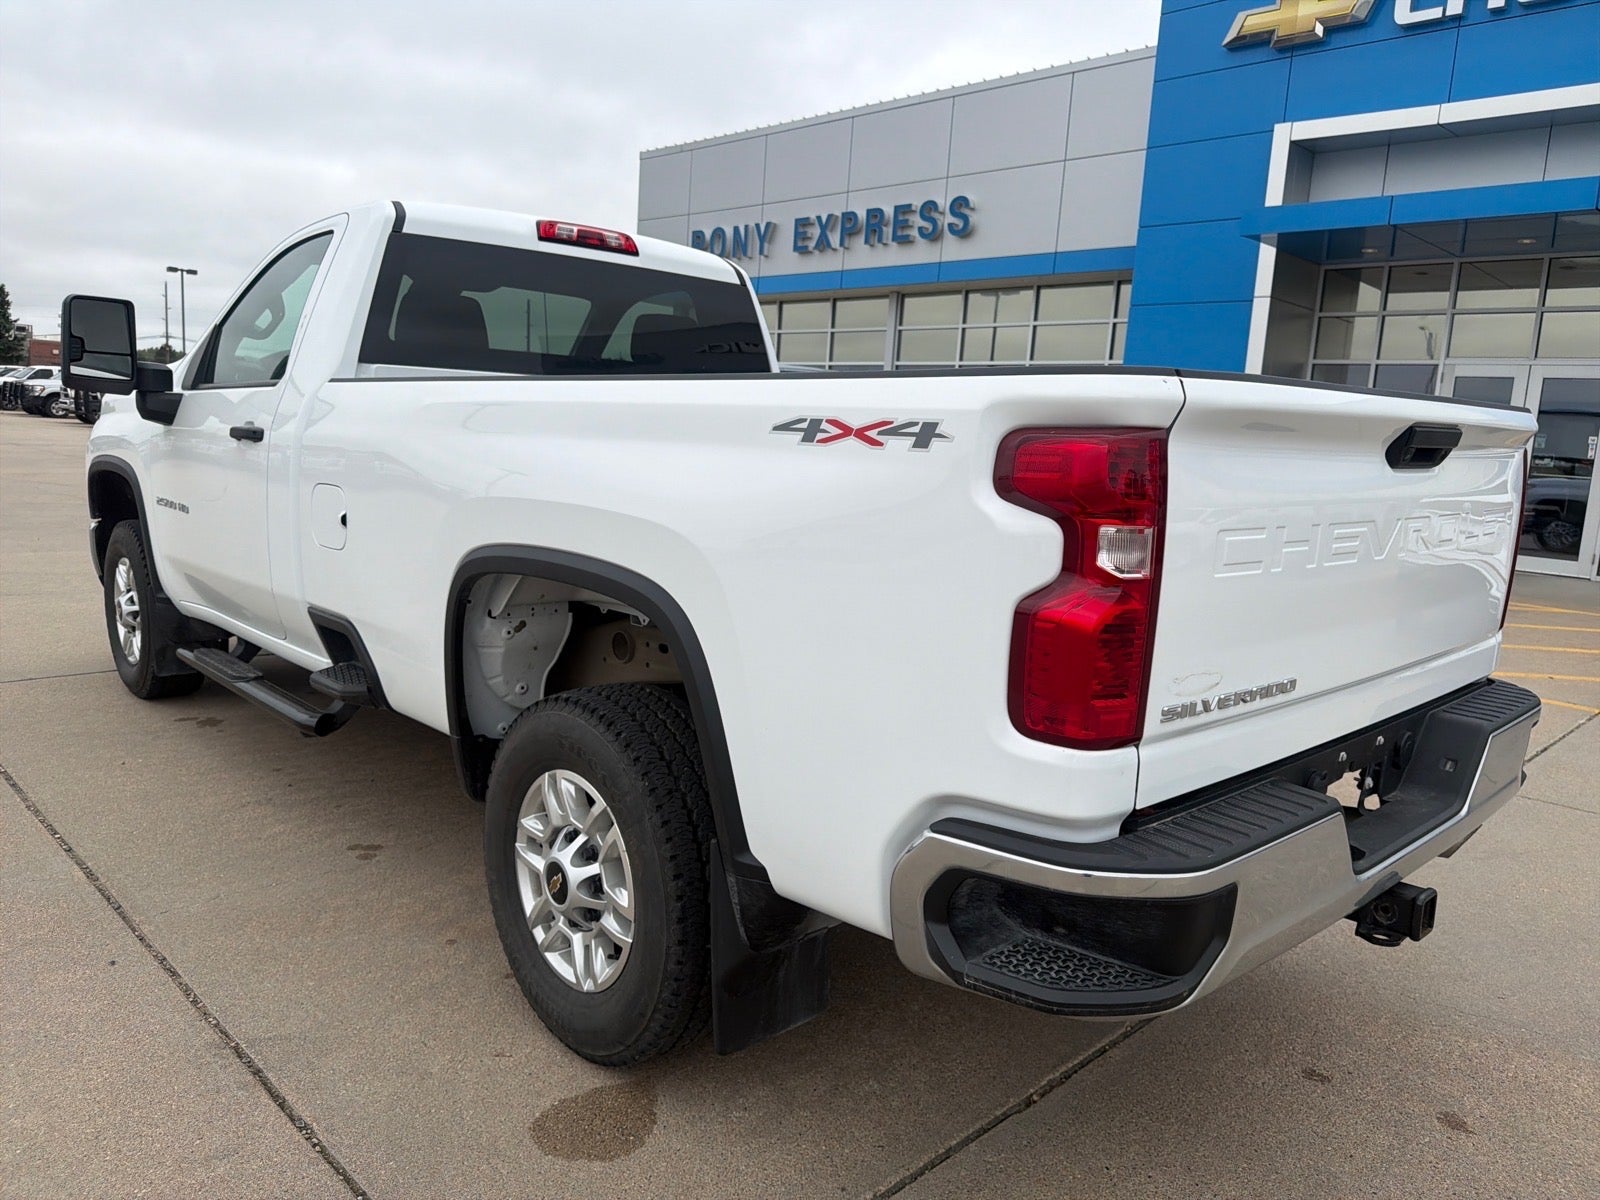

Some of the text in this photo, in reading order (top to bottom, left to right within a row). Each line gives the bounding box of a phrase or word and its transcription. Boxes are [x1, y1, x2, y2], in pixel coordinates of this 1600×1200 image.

[691, 195, 975, 258] PONY EXPRESS
[1160, 678, 1297, 723] SILVERADO
